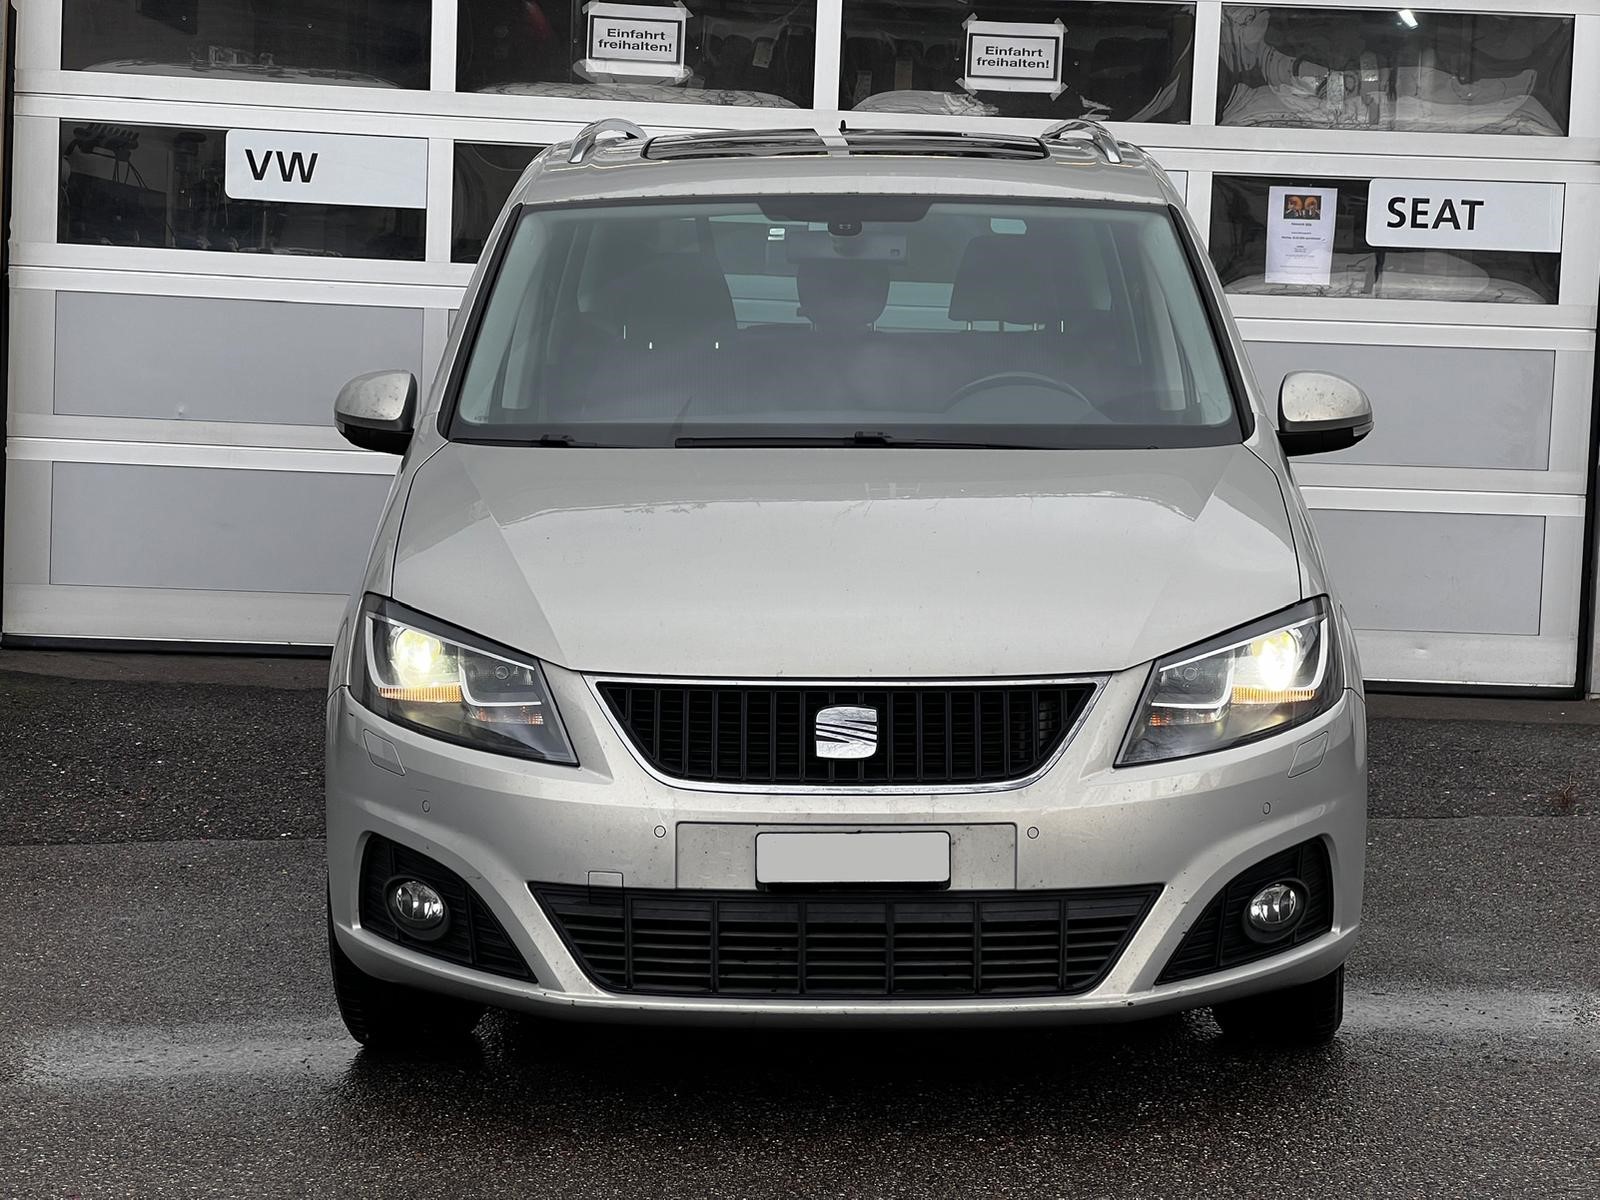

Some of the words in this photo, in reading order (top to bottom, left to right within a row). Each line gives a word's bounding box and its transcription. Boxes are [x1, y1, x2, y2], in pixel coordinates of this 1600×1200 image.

[607, 28, 666, 41] Einfahrt
[598, 39, 673, 53] freihalten!
[985, 45, 1043, 58] Einfahrt
[976, 57, 1050, 69] freihalten!
[245, 149, 319, 184] VW
[1386, 197, 1485, 231] SEAT
